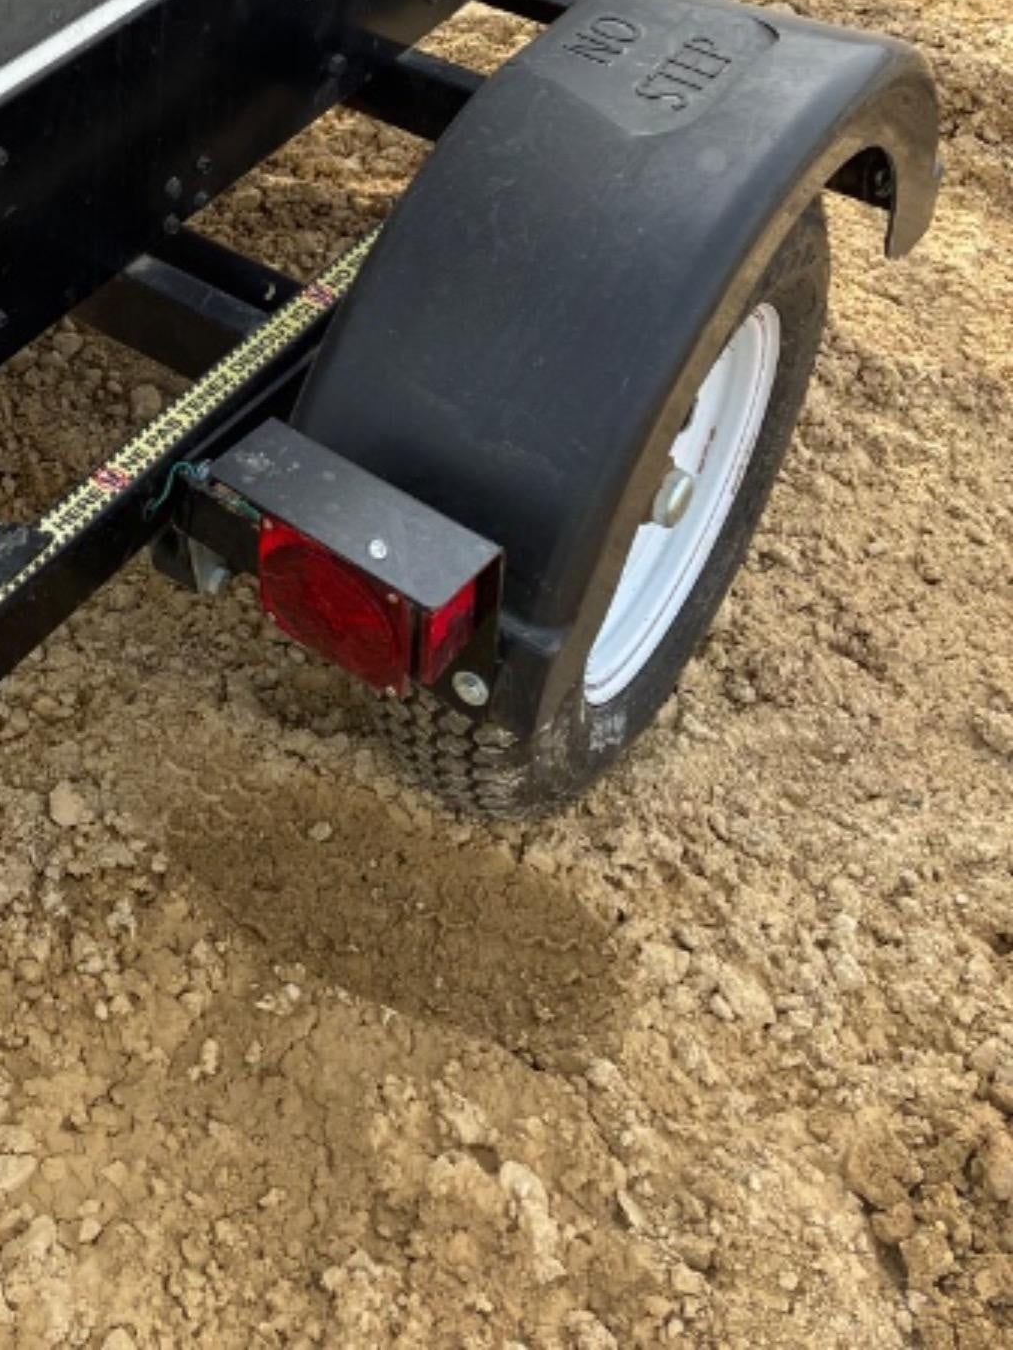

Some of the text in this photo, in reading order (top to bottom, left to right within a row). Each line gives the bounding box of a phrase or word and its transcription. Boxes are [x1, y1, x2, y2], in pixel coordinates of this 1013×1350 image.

[562, 16, 641, 66] NO
[635, 36, 733, 112] STEP
[52, 484, 105, 530] HERE
